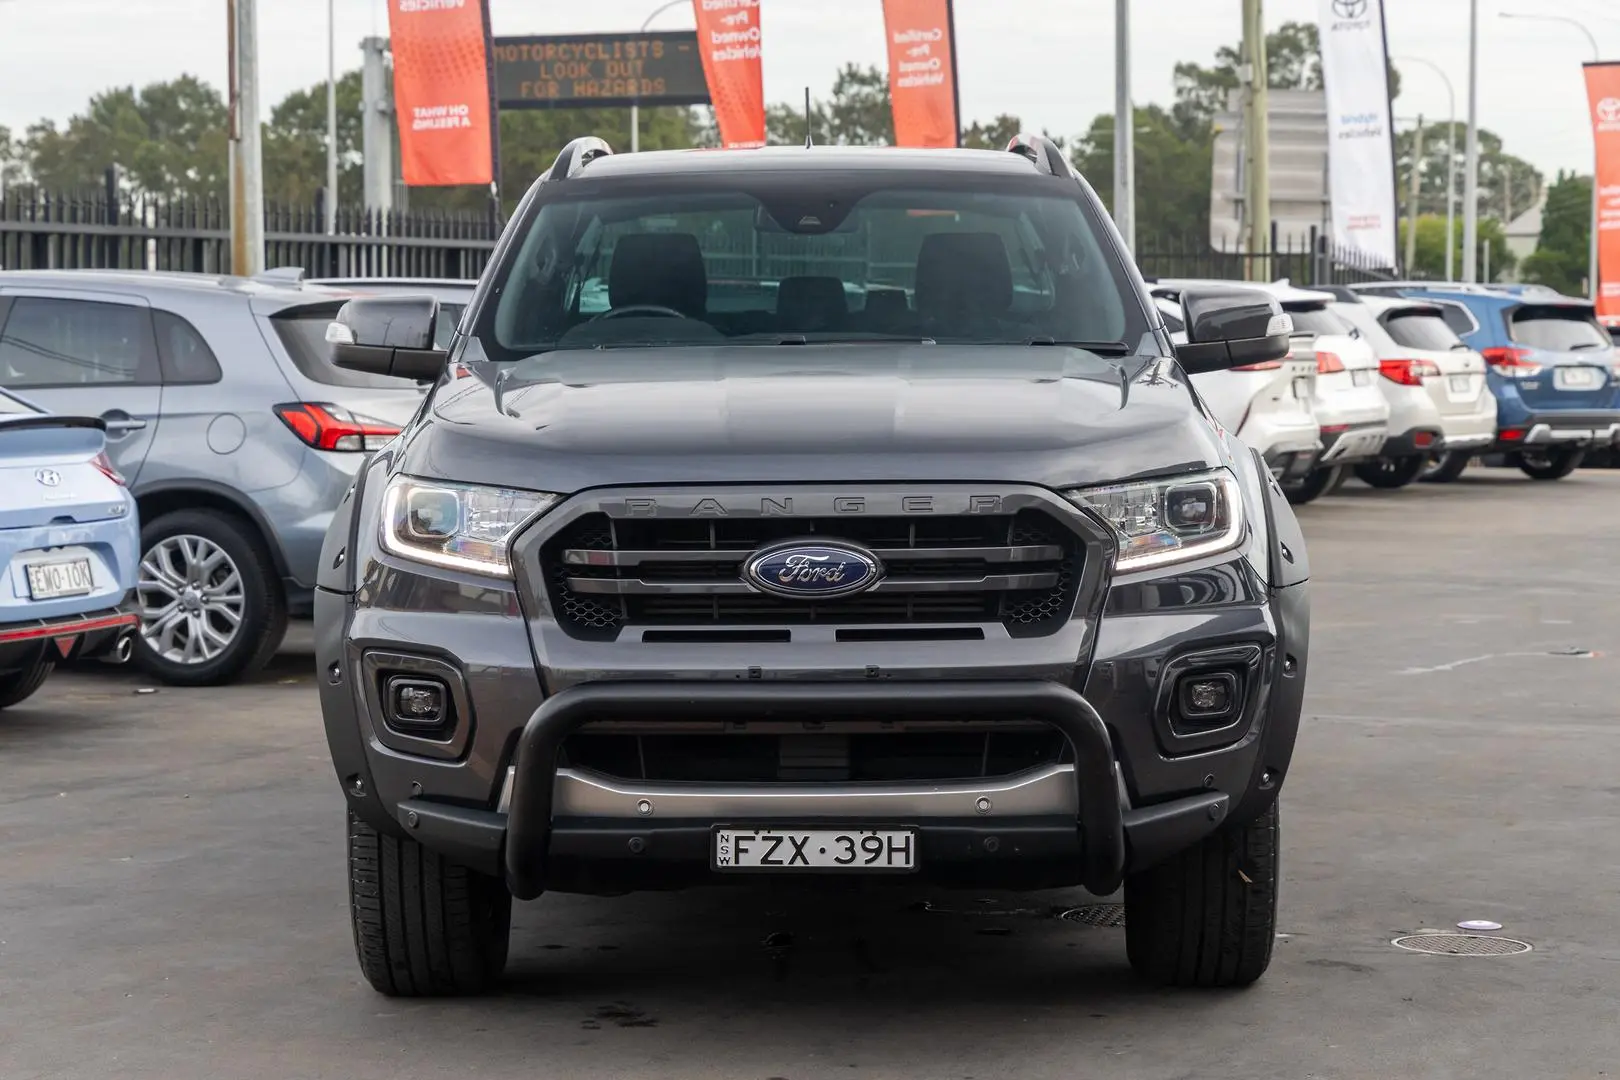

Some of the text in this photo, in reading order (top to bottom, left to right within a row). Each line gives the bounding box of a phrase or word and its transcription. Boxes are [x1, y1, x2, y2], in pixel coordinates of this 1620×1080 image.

[493, 40, 664, 62] MOTORCYCLISTS
[540, 60, 644, 79] LOOK OUT
[521, 77, 666, 98] FOR HAZARDS
[625, 494, 1001, 517] RANGER
[779, 554, 847, 582] Ford
[719, 834, 731, 865] NSW
